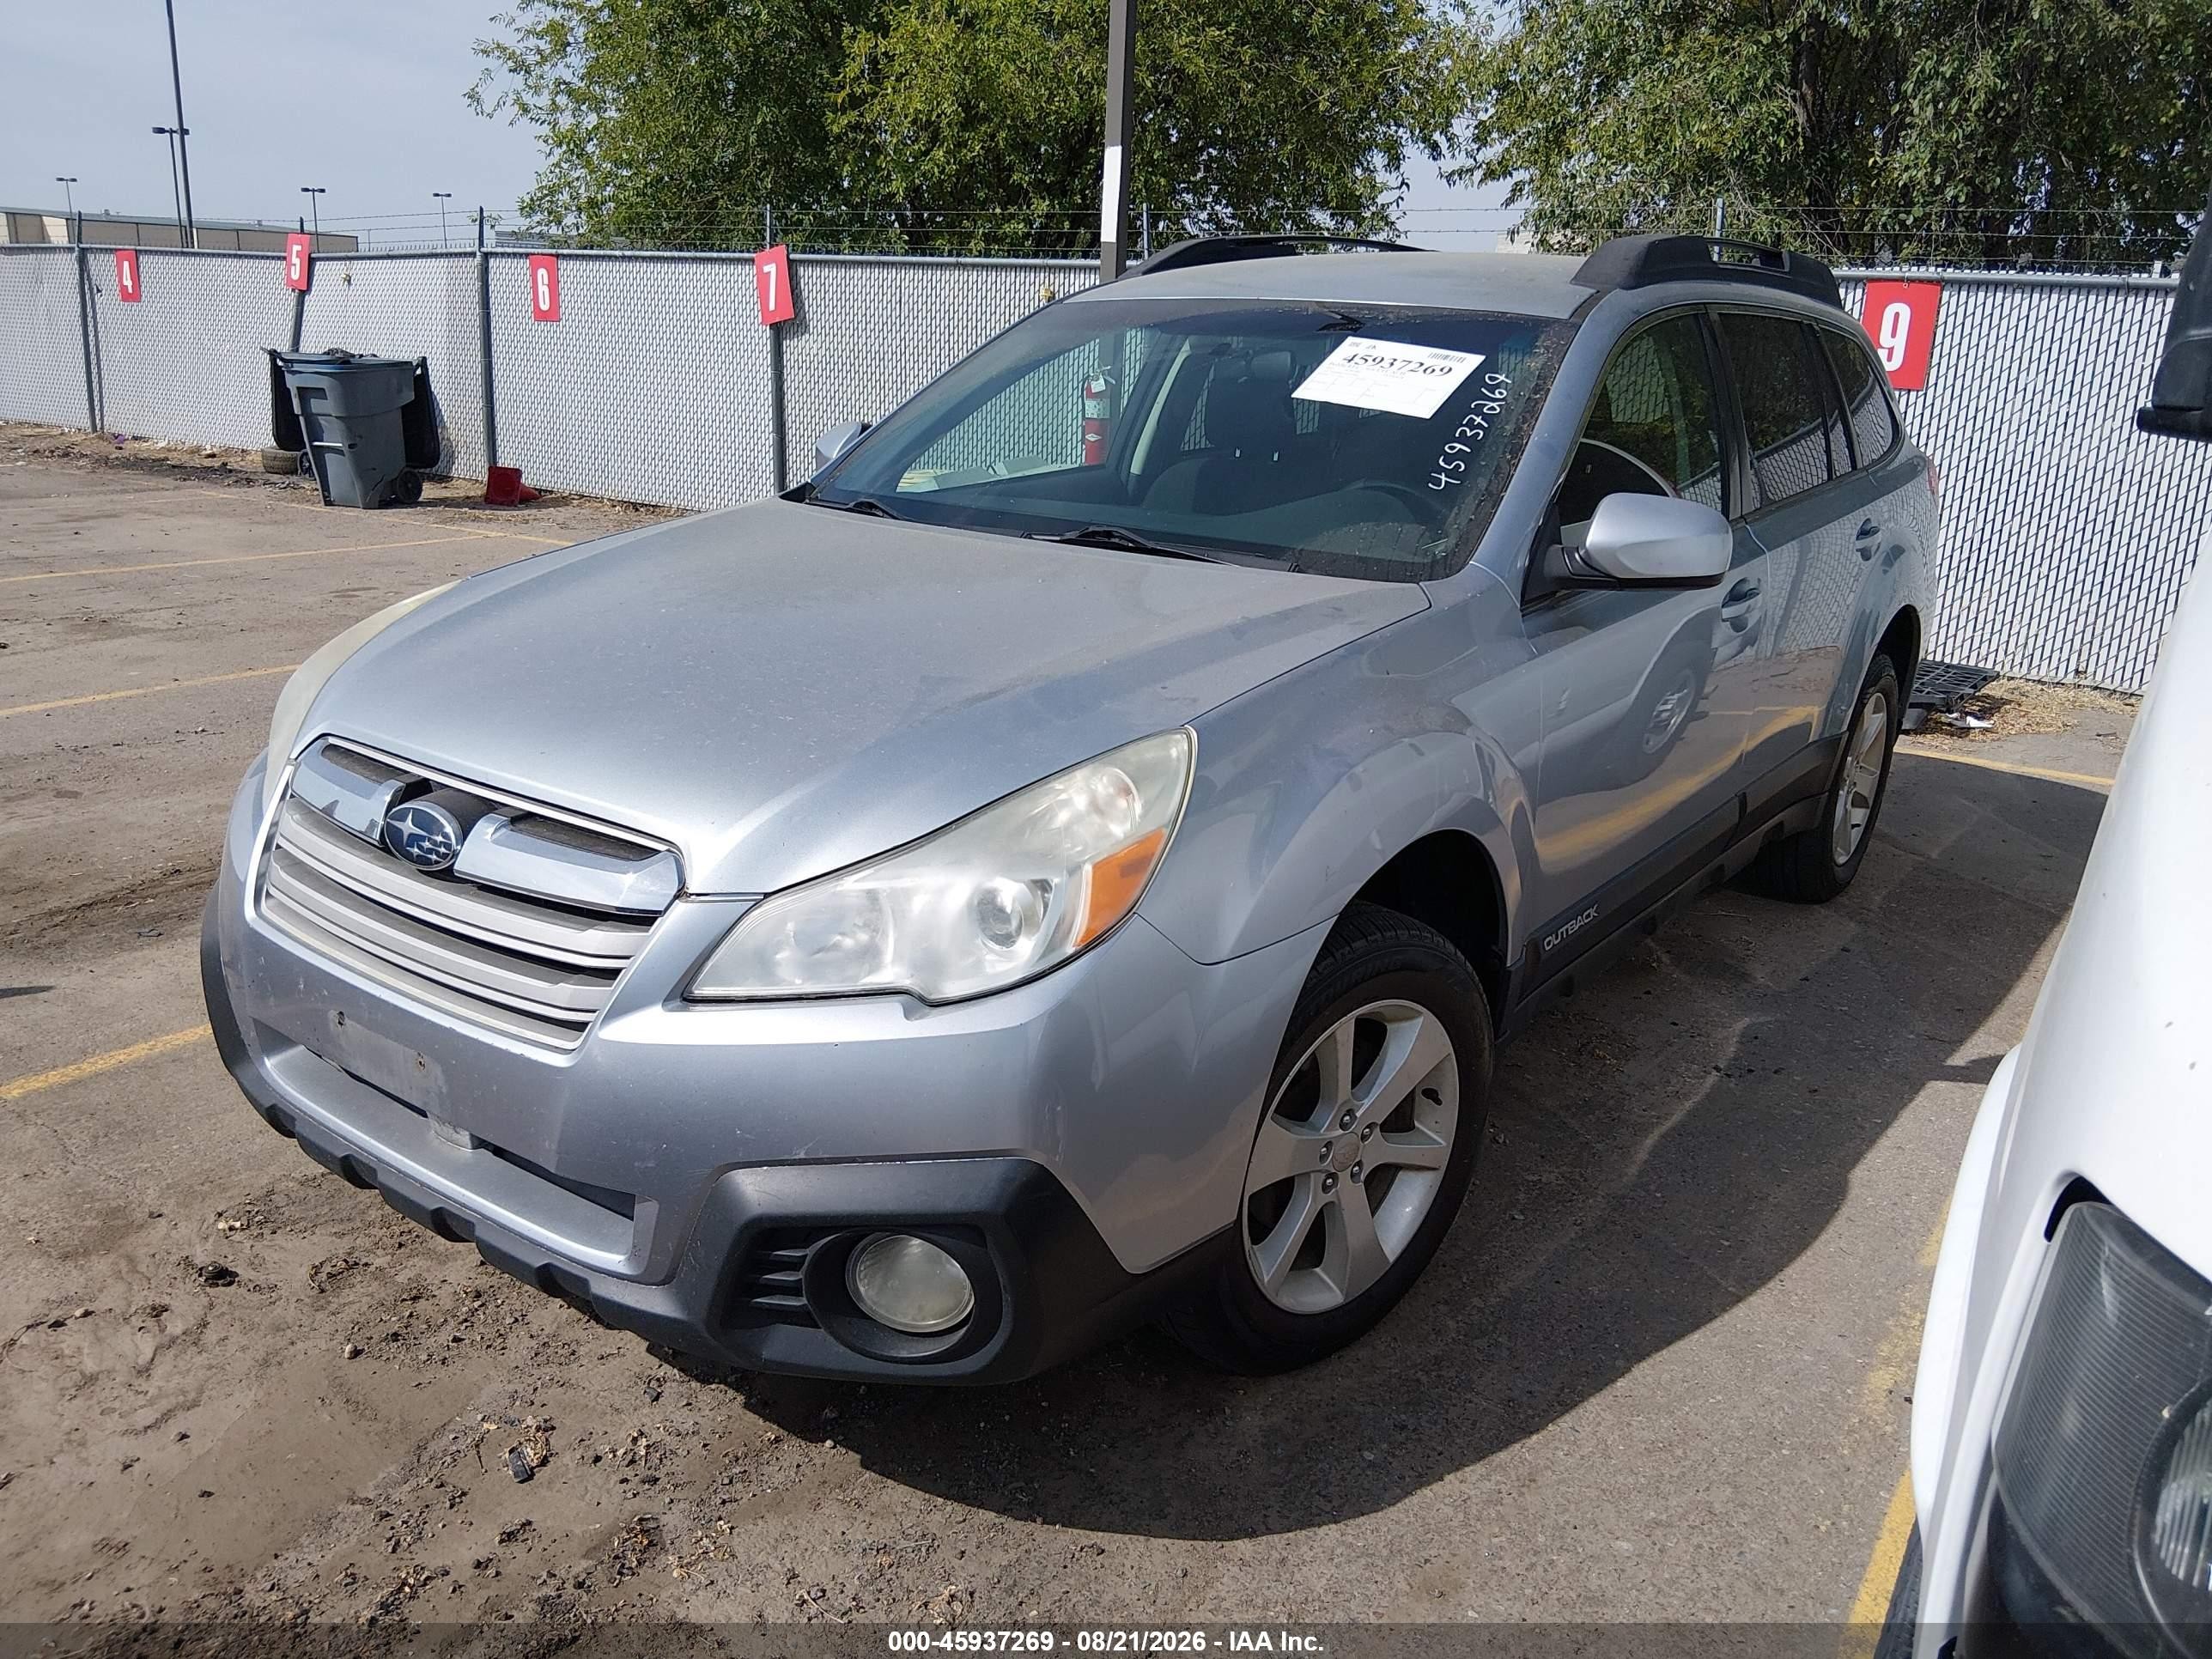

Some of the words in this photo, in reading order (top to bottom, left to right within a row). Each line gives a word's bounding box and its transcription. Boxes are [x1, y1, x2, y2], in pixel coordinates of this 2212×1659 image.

[121, 260, 133, 294] 4
[289, 244, 302, 281] 5
[537, 267, 550, 312] 6
[763, 262, 777, 312] 7
[1877, 302, 1911, 372] 9
[1342, 352, 1454, 377] 45937269
[1428, 372, 1512, 491] 45937269
[1543, 903, 1600, 951] OUTBACK
